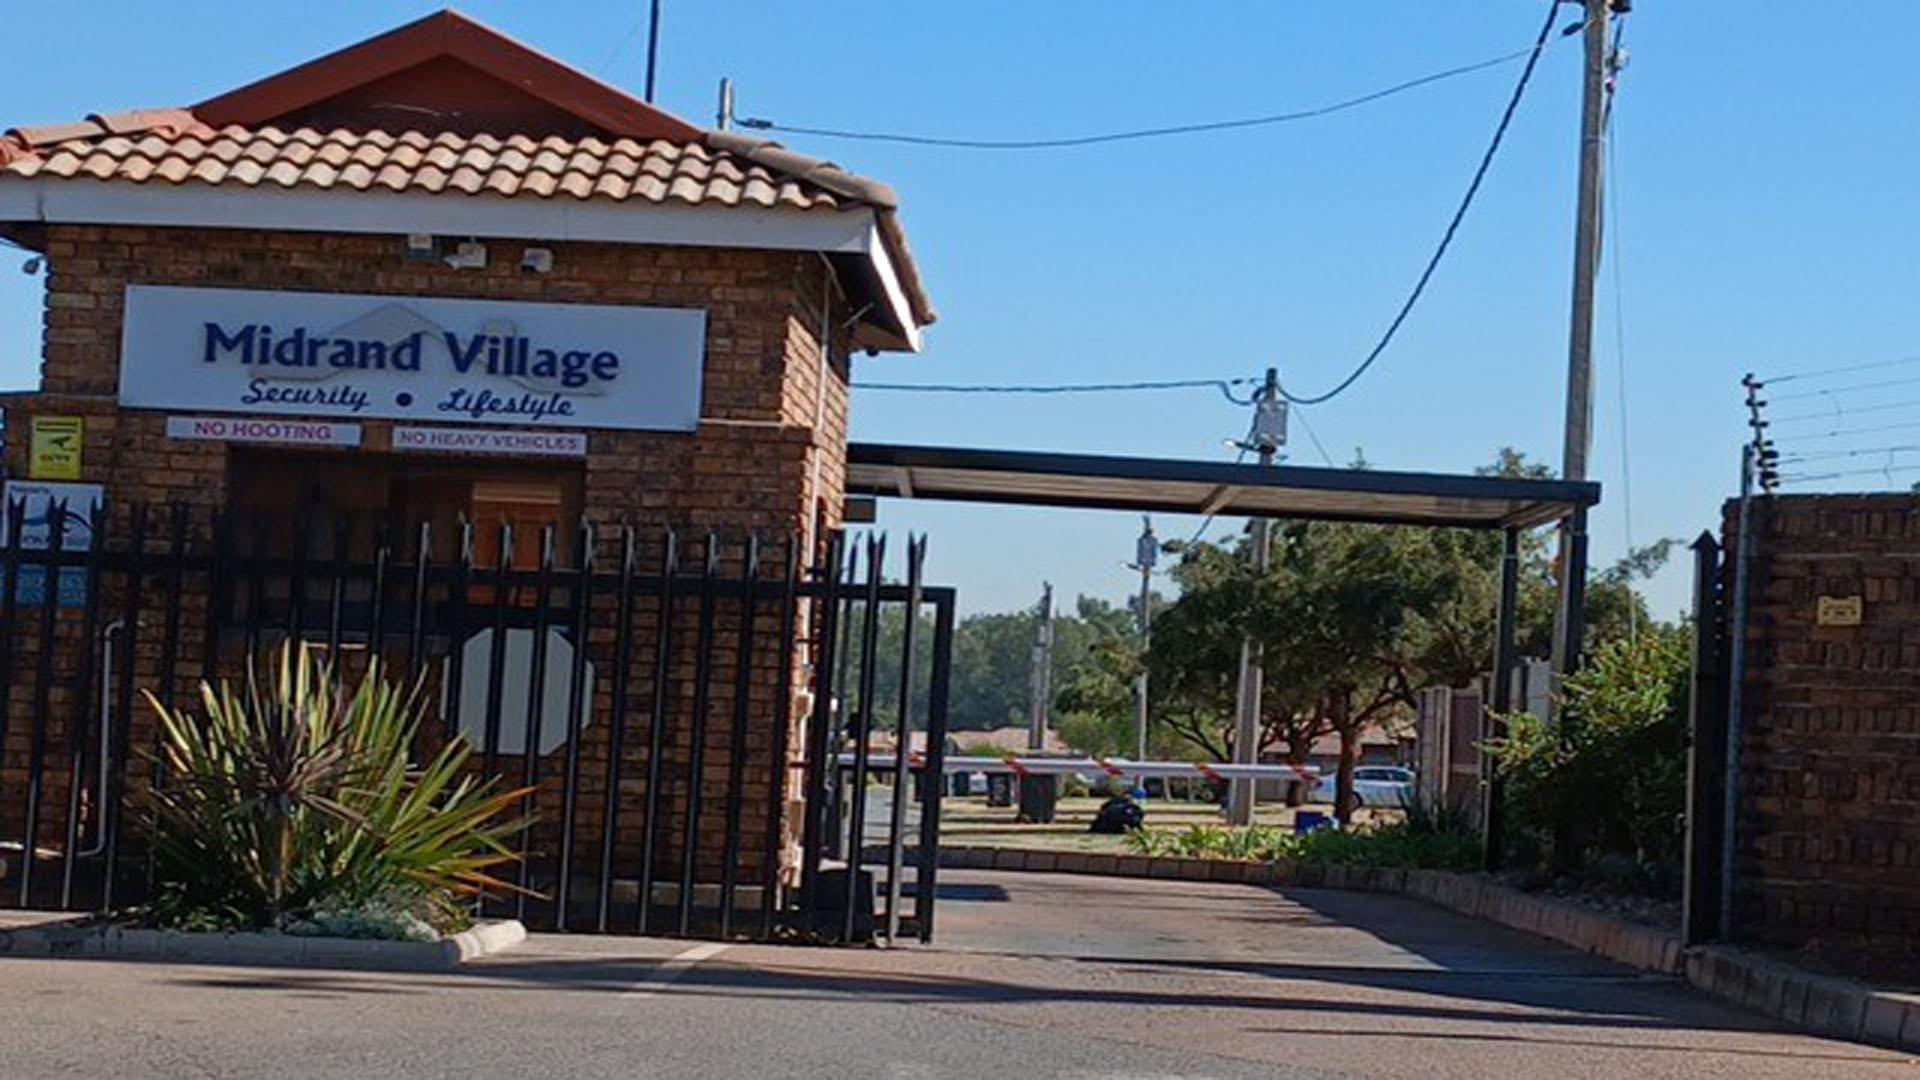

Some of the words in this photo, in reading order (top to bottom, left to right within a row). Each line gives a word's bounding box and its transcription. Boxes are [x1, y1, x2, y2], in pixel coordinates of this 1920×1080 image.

[203, 322, 422, 371] Midrand
[443, 331, 619, 388] Village
[241, 377, 370, 411] Security
[437, 388, 575, 421] Lifestyle
[194, 421, 226, 436] NO
[233, 422, 332, 440] HOOTING
[400, 430, 426, 444] NO
[431, 432, 485, 447] HEAVY
[493, 435, 577, 449] VEHICLES
